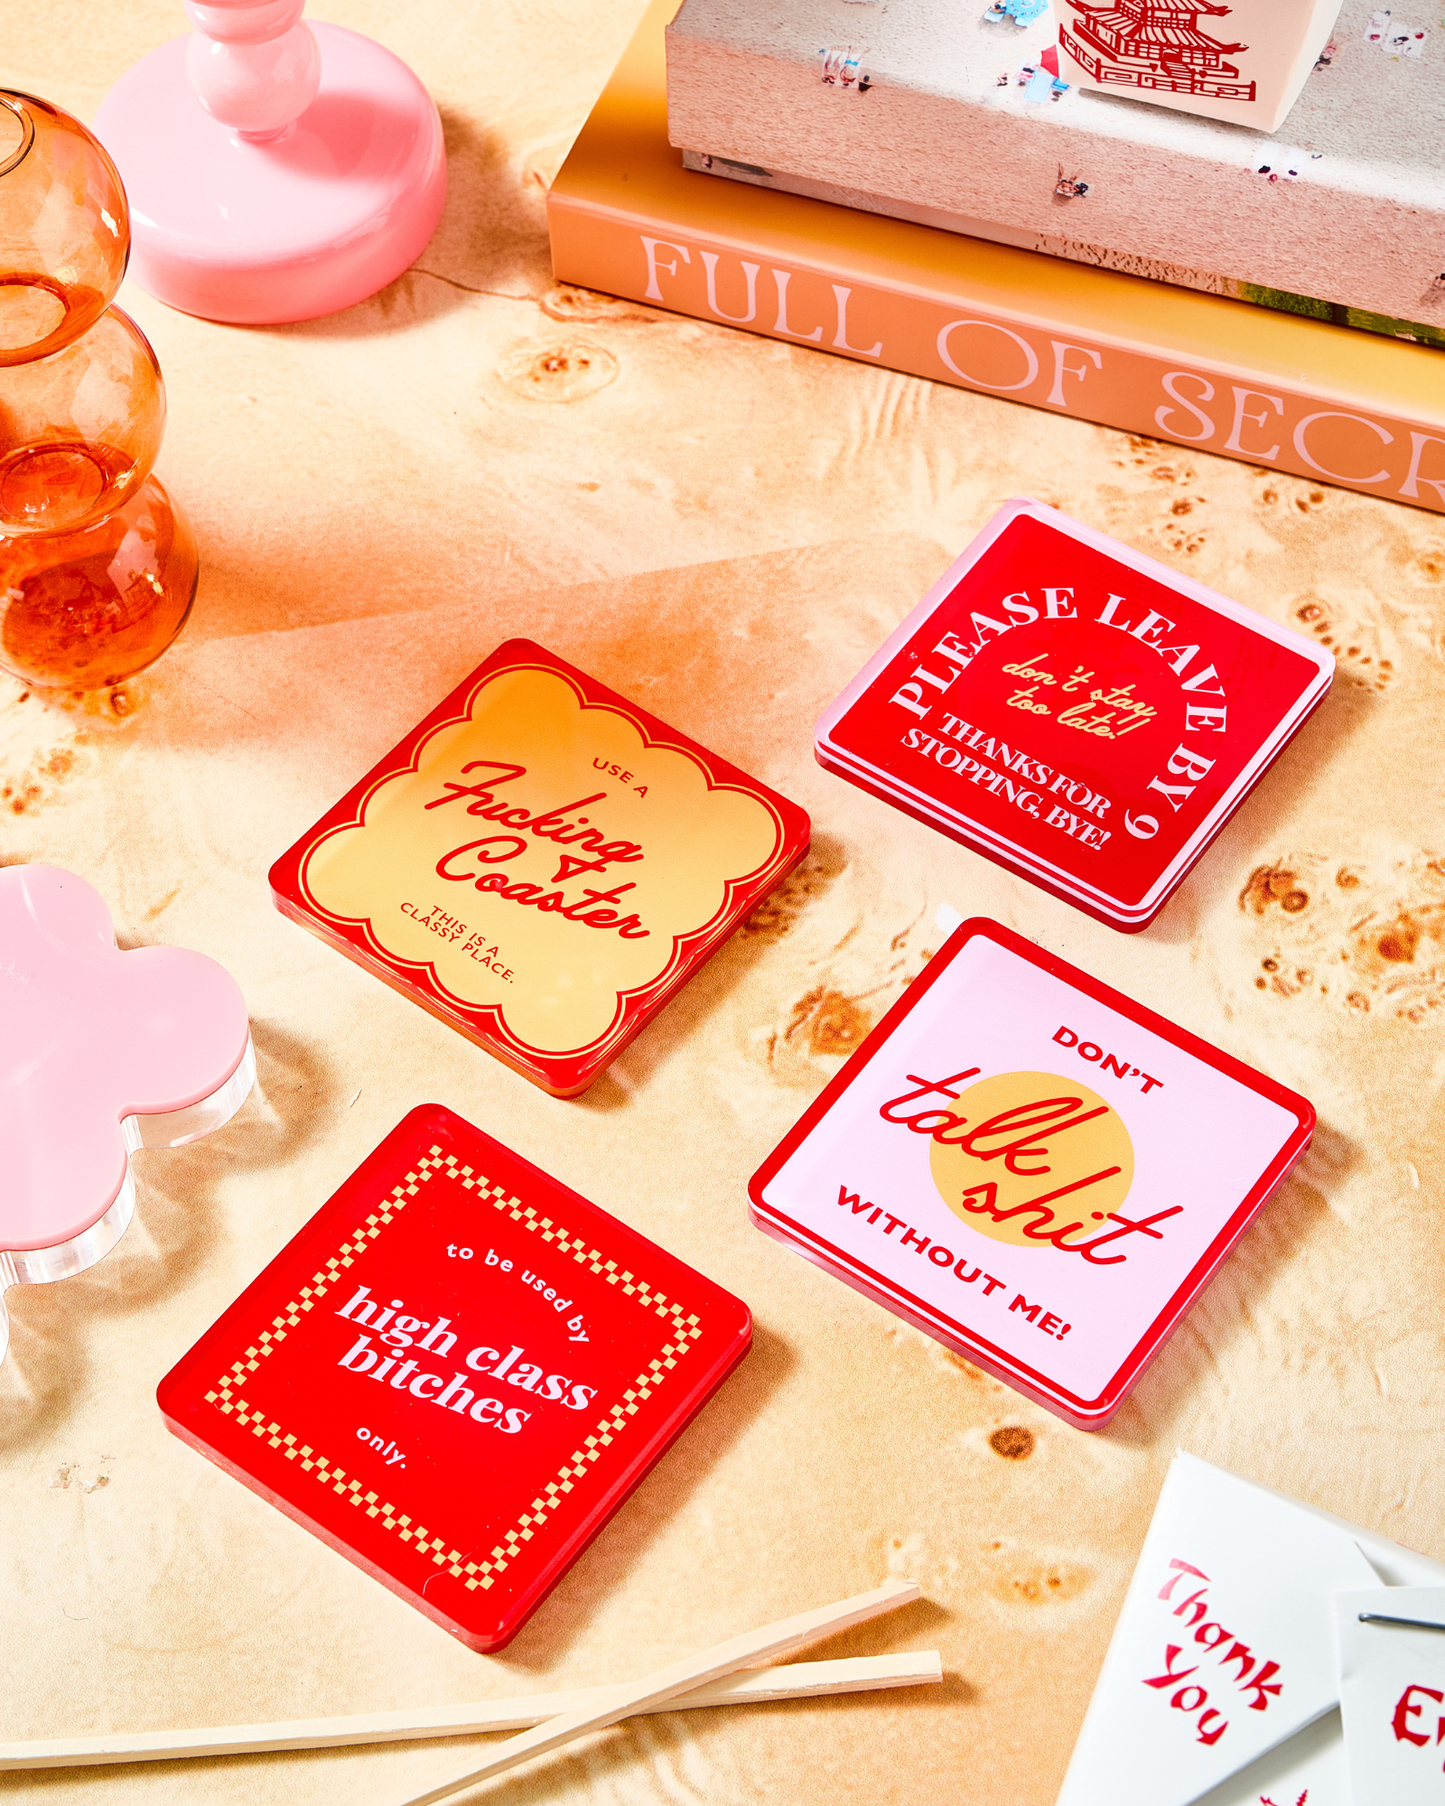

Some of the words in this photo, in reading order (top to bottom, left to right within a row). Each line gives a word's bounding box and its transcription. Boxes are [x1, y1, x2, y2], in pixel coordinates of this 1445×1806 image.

[639, 234, 883, 358] FULL
[936, 318, 1103, 408] OF
[889, 587, 1079, 720] PLEASE
[1001, 652, 1094, 692] don't
[1089, 683, 1158, 725] stay
[1094, 592, 1227, 733] LEAVE
[1006, 686, 1052, 715] too
[1056, 701, 1151, 740] late!
[592, 757, 635, 784] USE
[633, 785, 649, 799] A
[900, 728, 1044, 820] STOPPING,
[1043, 804, 1112, 851] BYE!
[938, 712, 1054, 785] THANKS
[1047, 773, 1112, 819] FOR
[1146, 743, 1217, 813] BY
[424, 760, 645, 884] Fucking
[1124, 809, 1159, 840] 9
[430, 905, 468, 934] THIS
[468, 932, 486, 947] IS
[486, 946, 499, 958] A
[435, 835, 651, 939] Coaster
[400, 902, 460, 943] CLASSY
[461, 942, 515, 985] PLACE.
[1051, 1025, 1164, 1095] DON'T
[879, 1067, 1110, 1176] talk
[837, 1184, 1007, 1297] WITHOUT
[1007, 1293, 1072, 1341] ME!
[962, 1165, 1184, 1265] shit
[446, 1243, 474, 1260] to
[484, 1248, 514, 1273] be
[521, 1269, 573, 1313] used
[566, 1314, 591, 1345] by
[334, 1284, 458, 1358] high
[466, 1346, 599, 1411] class
[337, 1333, 533, 1434] bitches
[356, 1427, 407, 1470] only.
[1156, 1557, 1284, 1712] Thank
